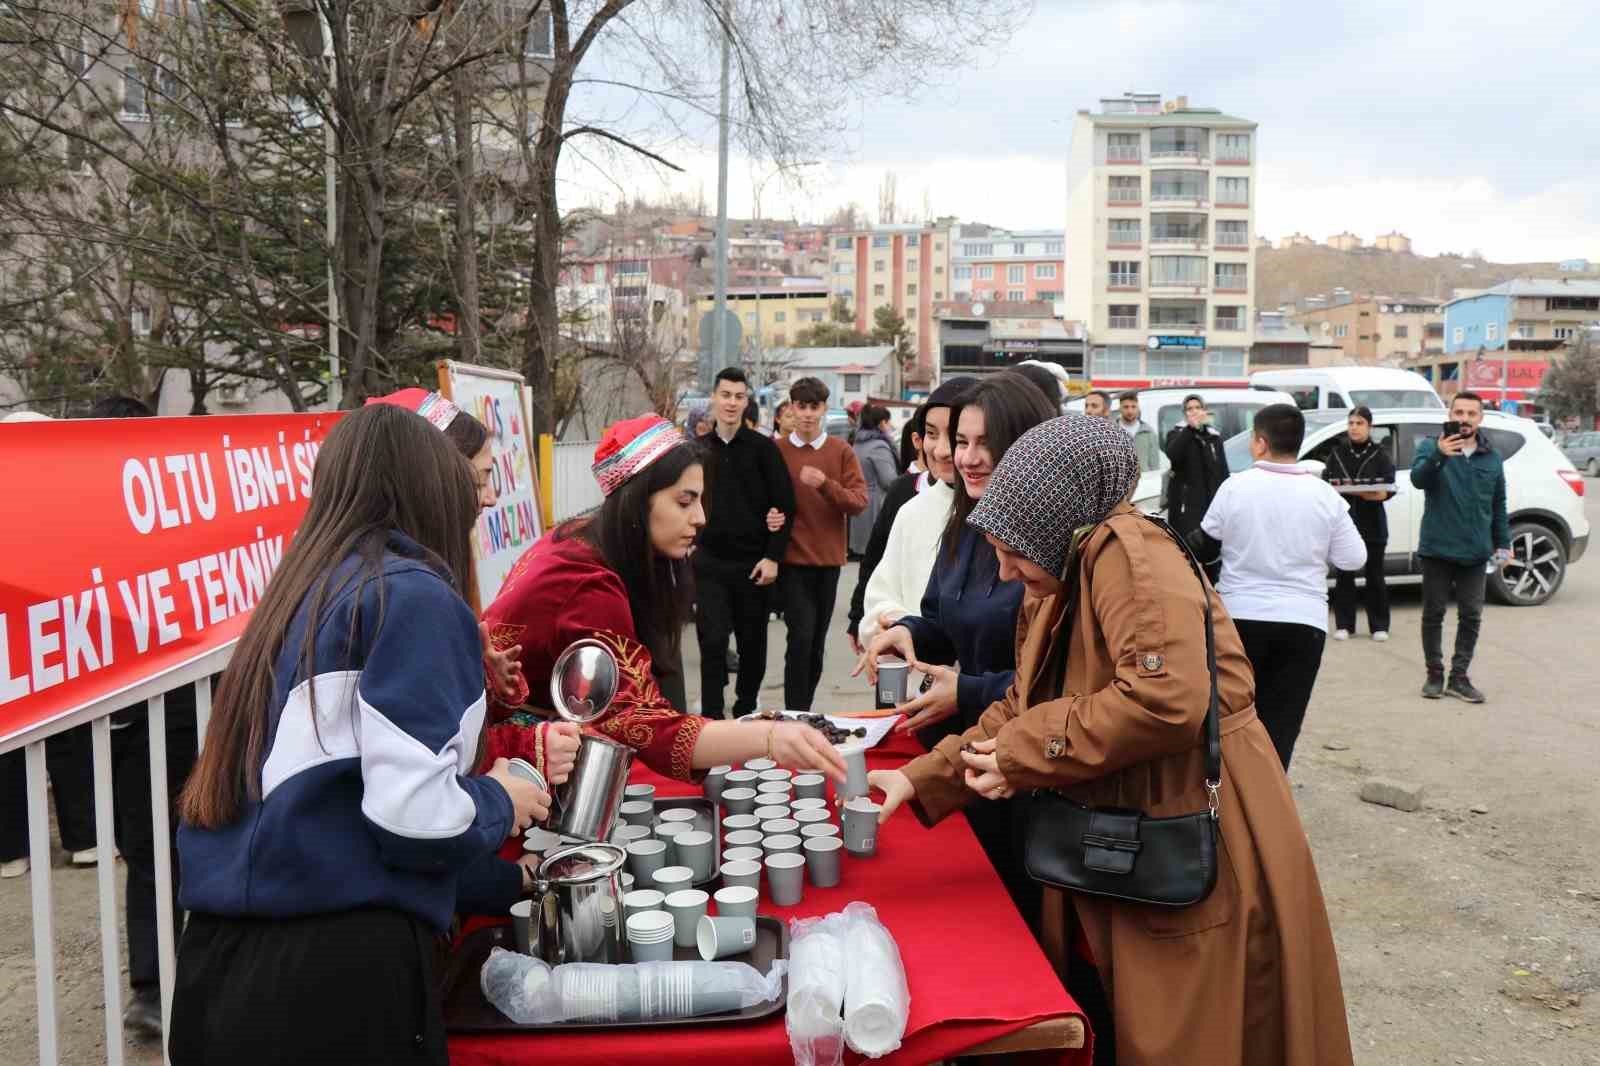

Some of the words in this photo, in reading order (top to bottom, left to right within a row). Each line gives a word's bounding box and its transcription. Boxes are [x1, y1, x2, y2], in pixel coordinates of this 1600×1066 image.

[122, 452, 217, 534] OLTU
[223, 431, 297, 513] İBN-İ
[117, 568, 183, 654] VE
